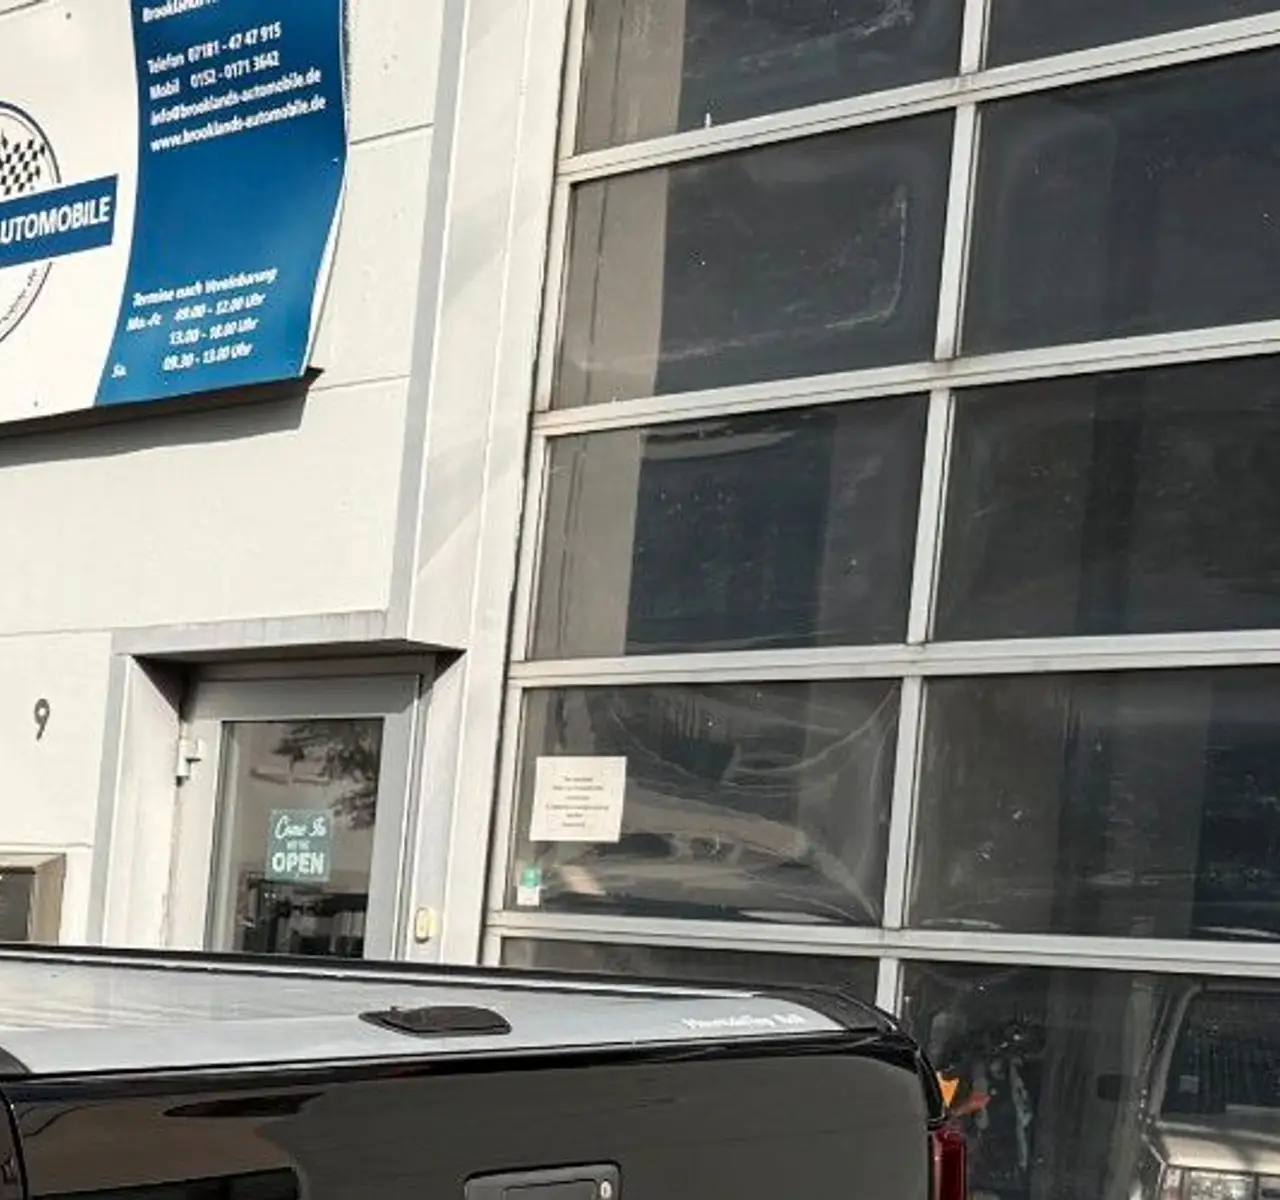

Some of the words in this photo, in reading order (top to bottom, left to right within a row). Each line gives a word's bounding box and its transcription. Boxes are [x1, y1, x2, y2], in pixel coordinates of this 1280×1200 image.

[147, 53, 185, 74] Telefon
[260, 21, 282, 43] 915
[149, 78, 180, 100] Mobil
[190, 69, 216, 88] 0152
[34, 698, 50, 742] 9
[272, 852, 324, 875] OPEN
